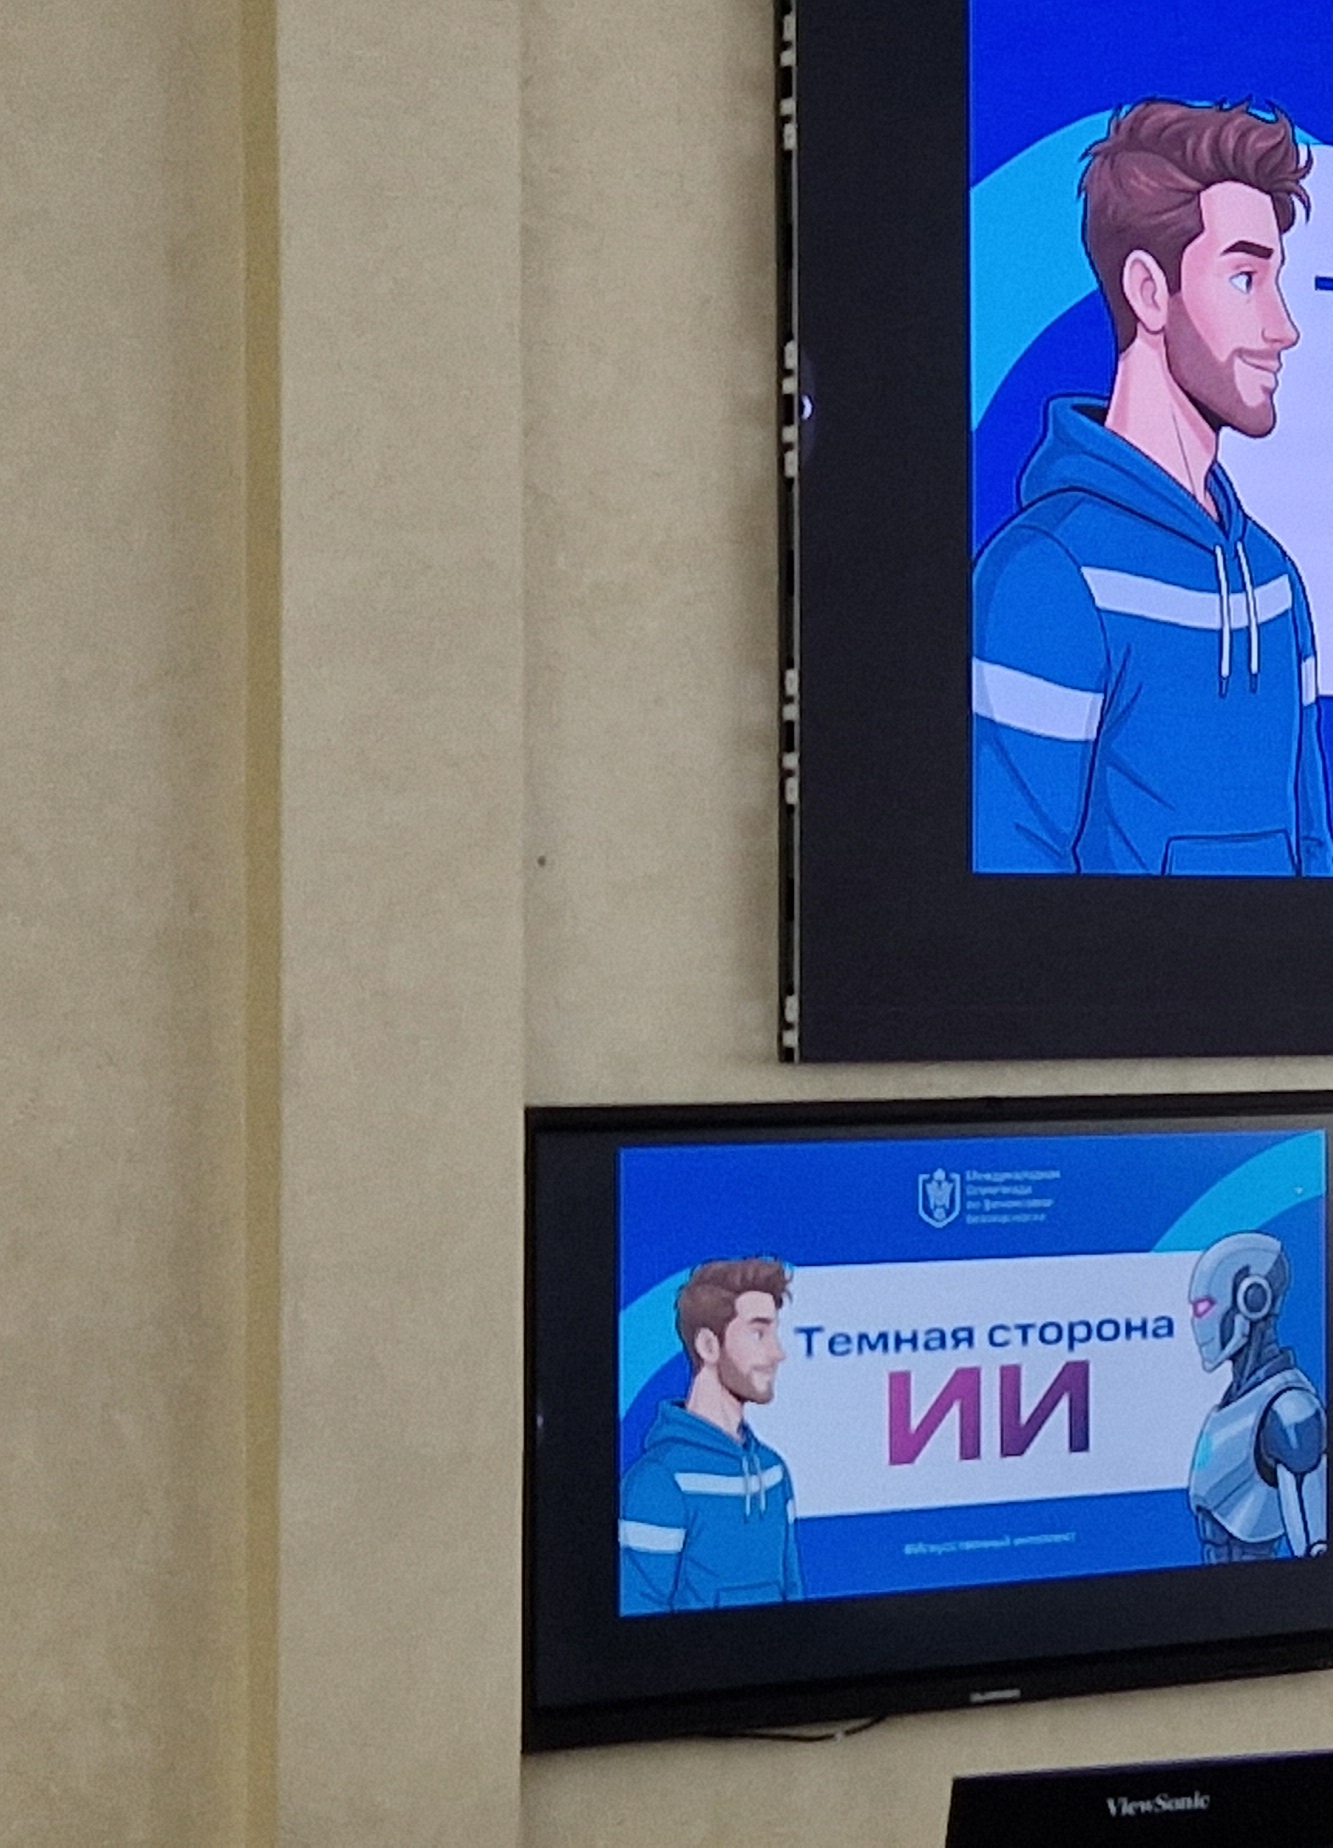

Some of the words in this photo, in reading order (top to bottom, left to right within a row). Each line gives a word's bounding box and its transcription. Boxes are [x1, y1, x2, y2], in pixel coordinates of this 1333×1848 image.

[795, 1326, 975, 1358] Темная
[987, 1315, 1174, 1353] сторона
[889, 1359, 1090, 1466] ИИ
[1106, 1790, 1210, 1817] ViewSonic
